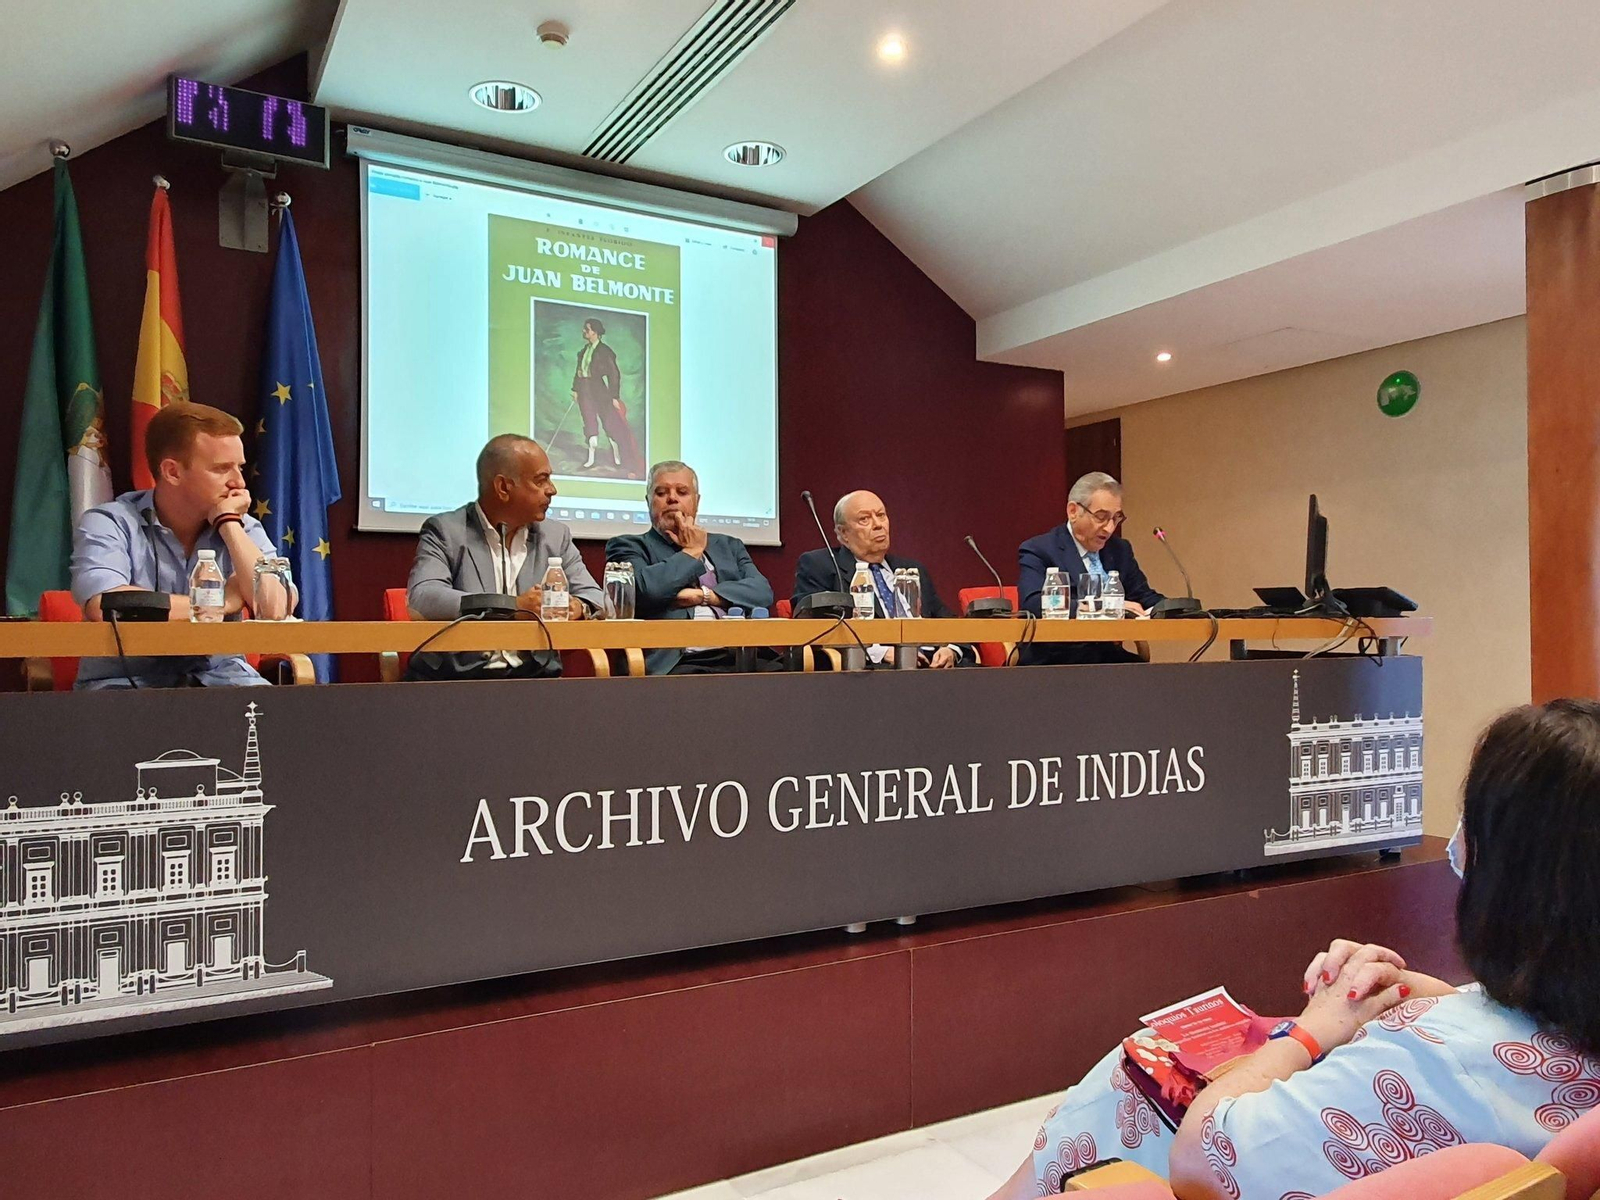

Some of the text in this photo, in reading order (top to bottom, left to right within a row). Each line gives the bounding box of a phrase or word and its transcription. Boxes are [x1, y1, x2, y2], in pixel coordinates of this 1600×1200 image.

[535, 237, 646, 271] ROMANCE
[580, 264, 600, 275] DE
[502, 264, 674, 305] JUAN BELMONTE
[459, 745, 1206, 863] ARCHIVO GENERAL DE INDIAS
[1149, 1011, 1187, 1028] oloquios
